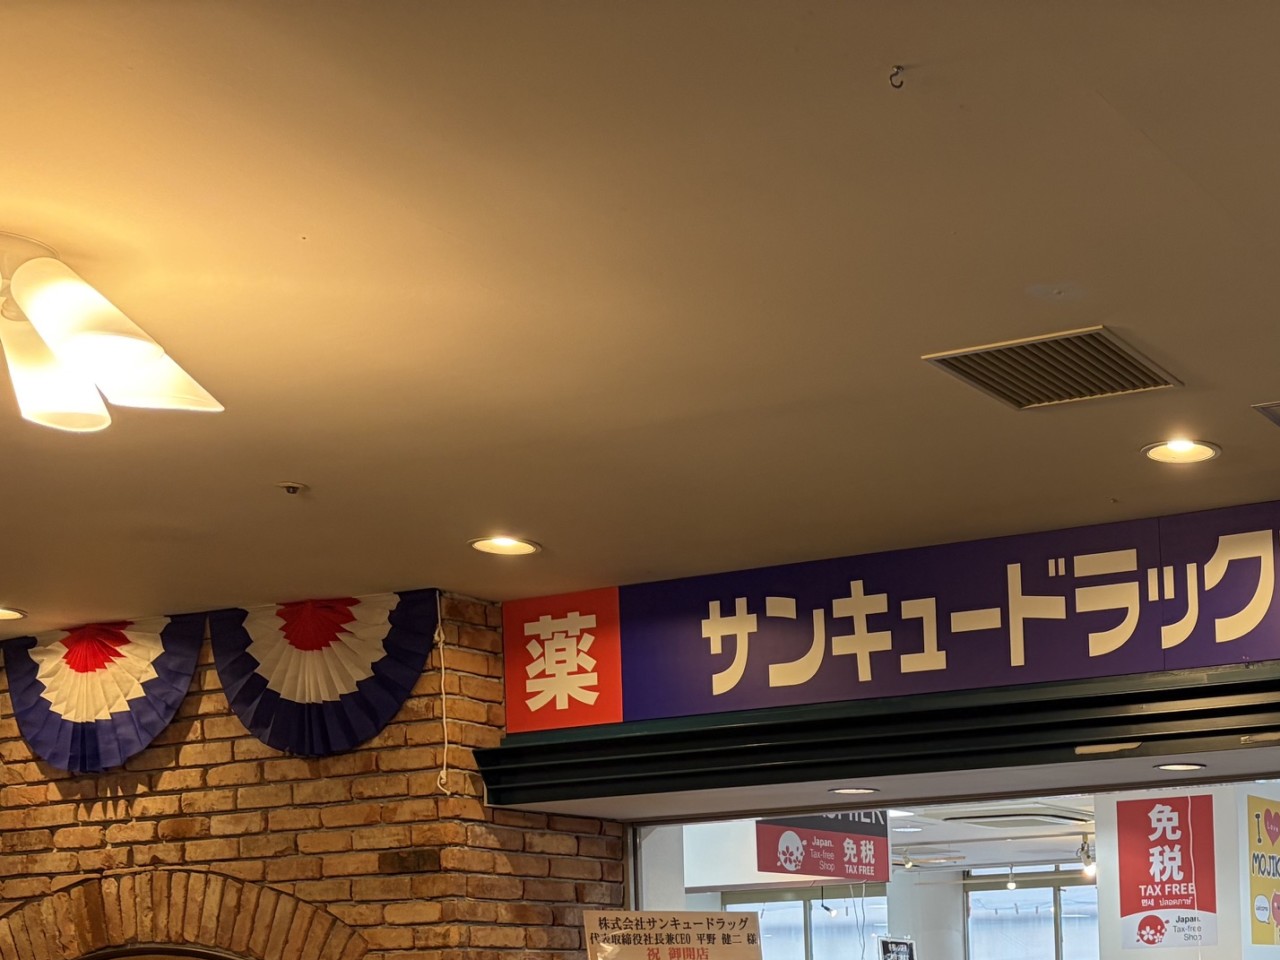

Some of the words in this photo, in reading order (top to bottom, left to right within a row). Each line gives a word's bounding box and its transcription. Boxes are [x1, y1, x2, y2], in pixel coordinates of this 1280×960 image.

[525, 609, 599, 711] 薬
[1255, 813, 1262, 843] I
[1147, 803, 1184, 882] 免税
[810, 848, 835, 860] Tax-free
[843, 837, 875, 864] 免税
[819, 860, 835, 872] Shop
[845, 864, 857, 874] TAX
[859, 865, 875, 876] FREE
[1139, 884, 1162, 896] TAX
[1165, 882, 1195, 895] FREE
[598, 917, 749, 931] 株式会社サンキュードラッグ
[590, 933, 691, 945] 代表取締役社長兼CEO
[696, 933, 716, 945] 平野
[722, 933, 742, 945] 健二
[747, 933, 758, 945] 様
[647, 947, 660, 960] 祝
[668, 947, 709, 960] 御開店
